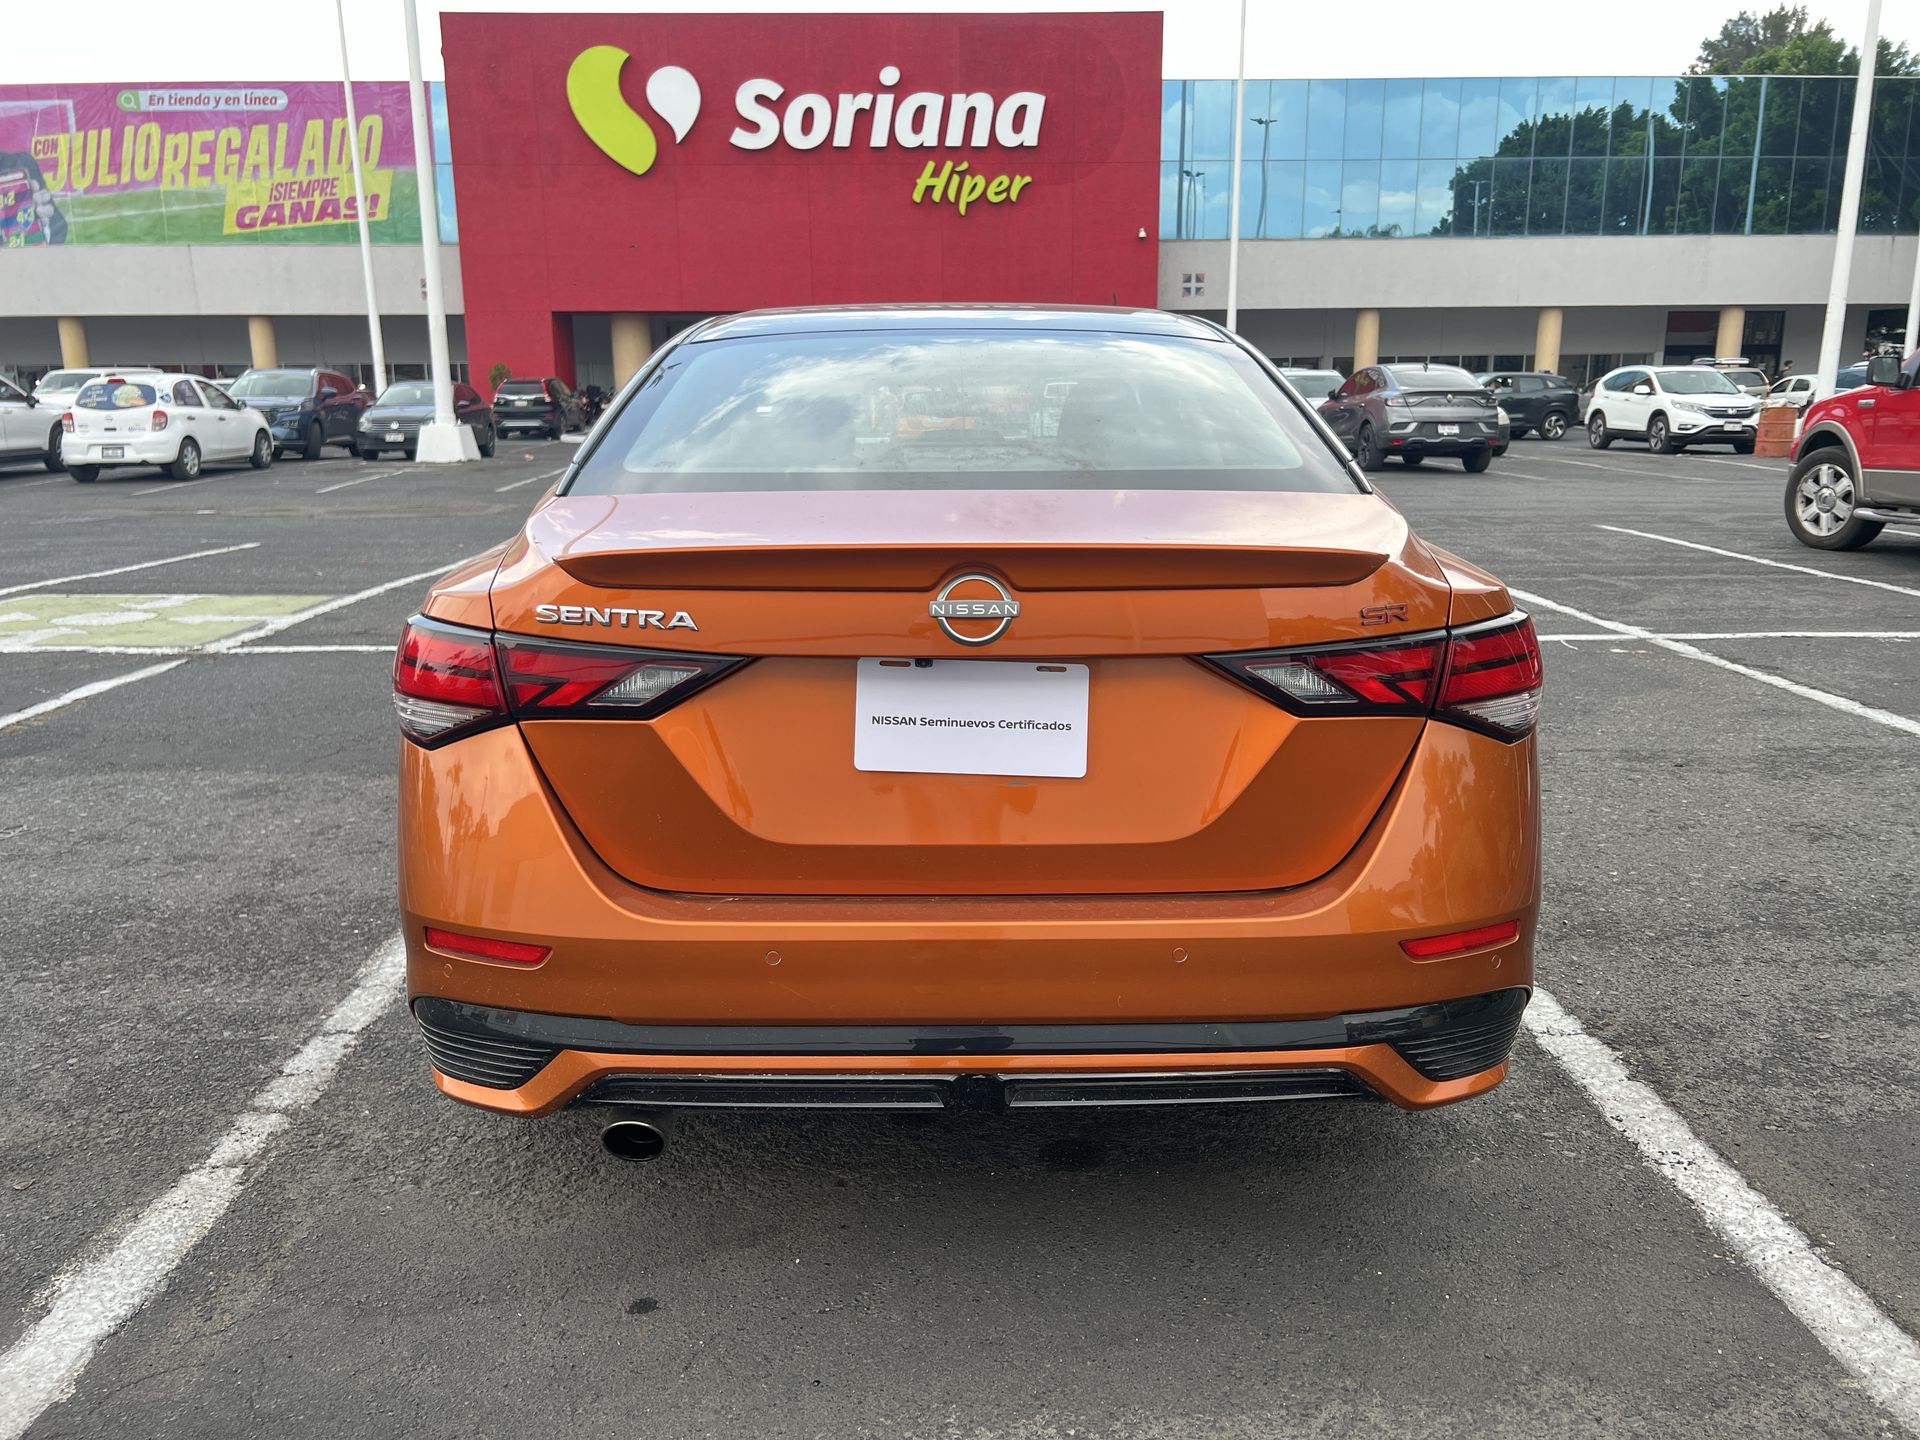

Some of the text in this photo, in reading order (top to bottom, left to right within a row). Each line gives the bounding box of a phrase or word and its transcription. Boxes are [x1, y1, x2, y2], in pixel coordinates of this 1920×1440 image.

[148, 92, 278, 109] En tienda y en línea
[728, 66, 1046, 150] Soriana
[34, 114, 383, 192] CON JULIO REGALADO
[912, 160, 1032, 216] Híper
[235, 193, 380, 230] GANAS!
[535, 604, 699, 631] SENTRA
[932, 604, 1018, 615] NISSAN
[1361, 603, 1409, 626] SR
[871, 715, 1073, 731] NISSAN Seminuevos Certificados
